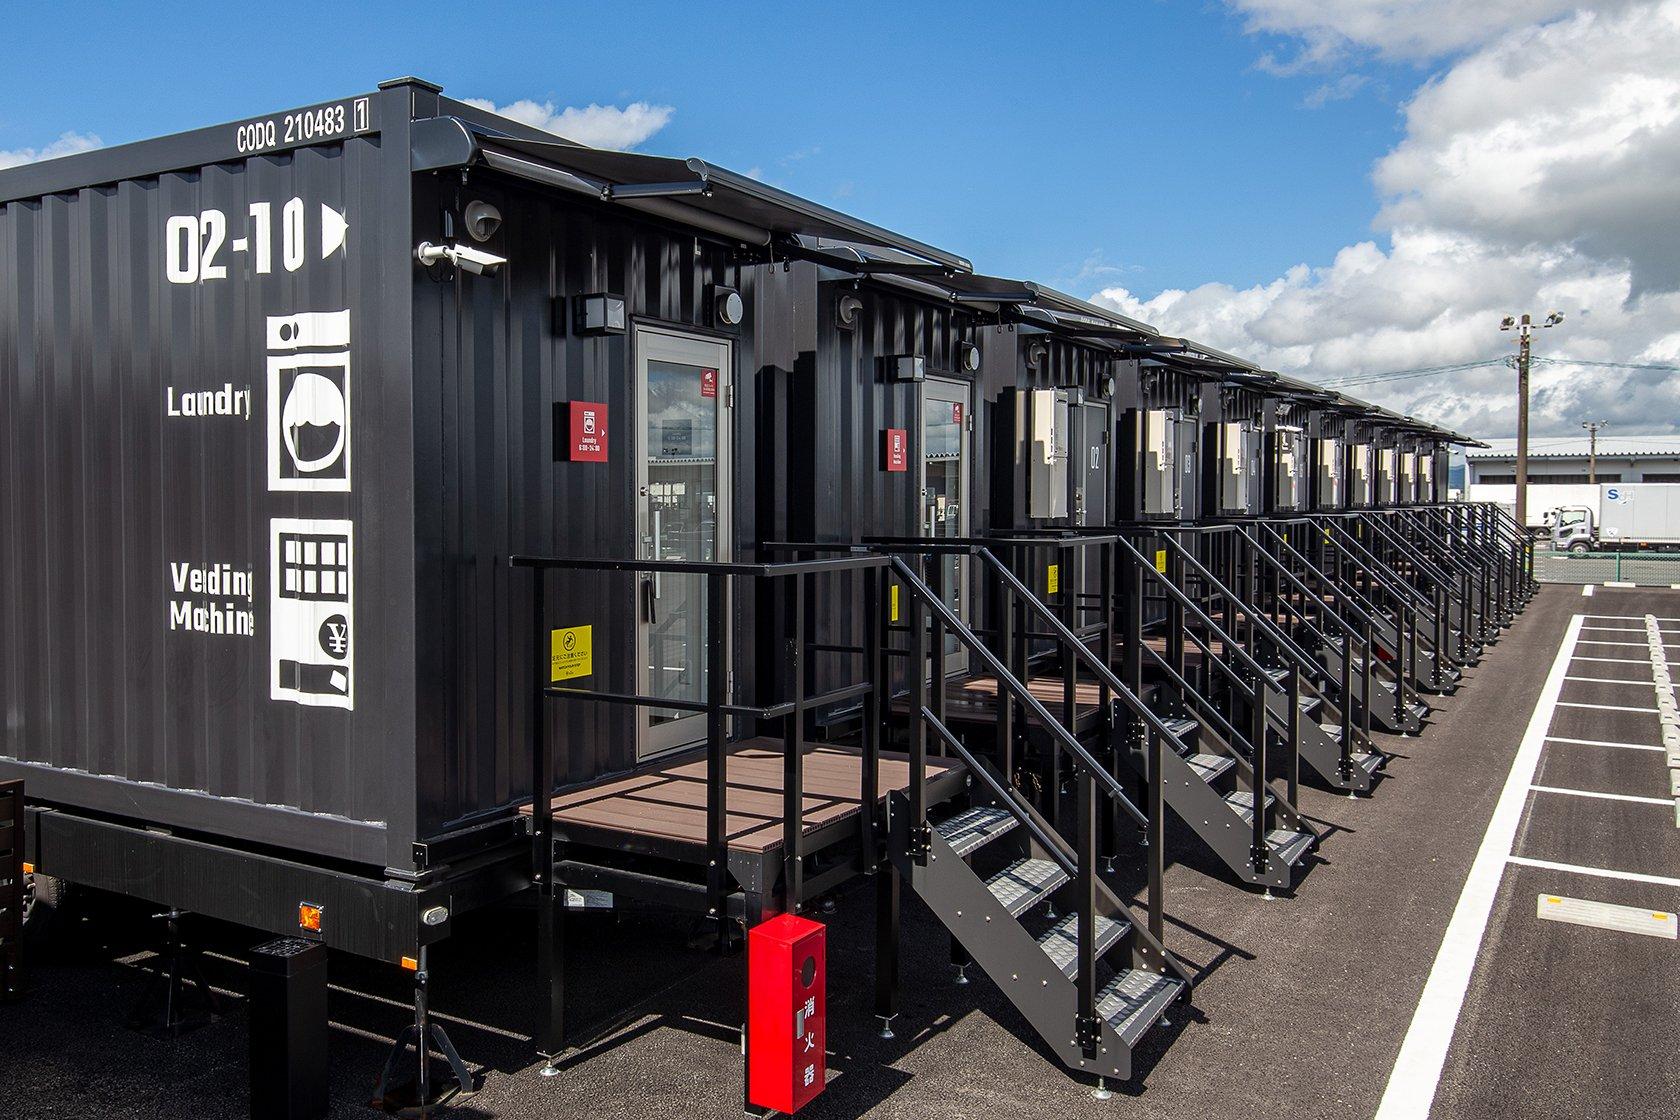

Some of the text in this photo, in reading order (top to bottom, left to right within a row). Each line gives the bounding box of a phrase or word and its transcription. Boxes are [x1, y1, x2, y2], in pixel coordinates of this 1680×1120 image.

[237, 99, 367, 153] CODQ 210483 1
[166, 197, 305, 284] 02-10
[170, 601, 254, 637] Machine
[803, 996, 816, 1087] 消火器
